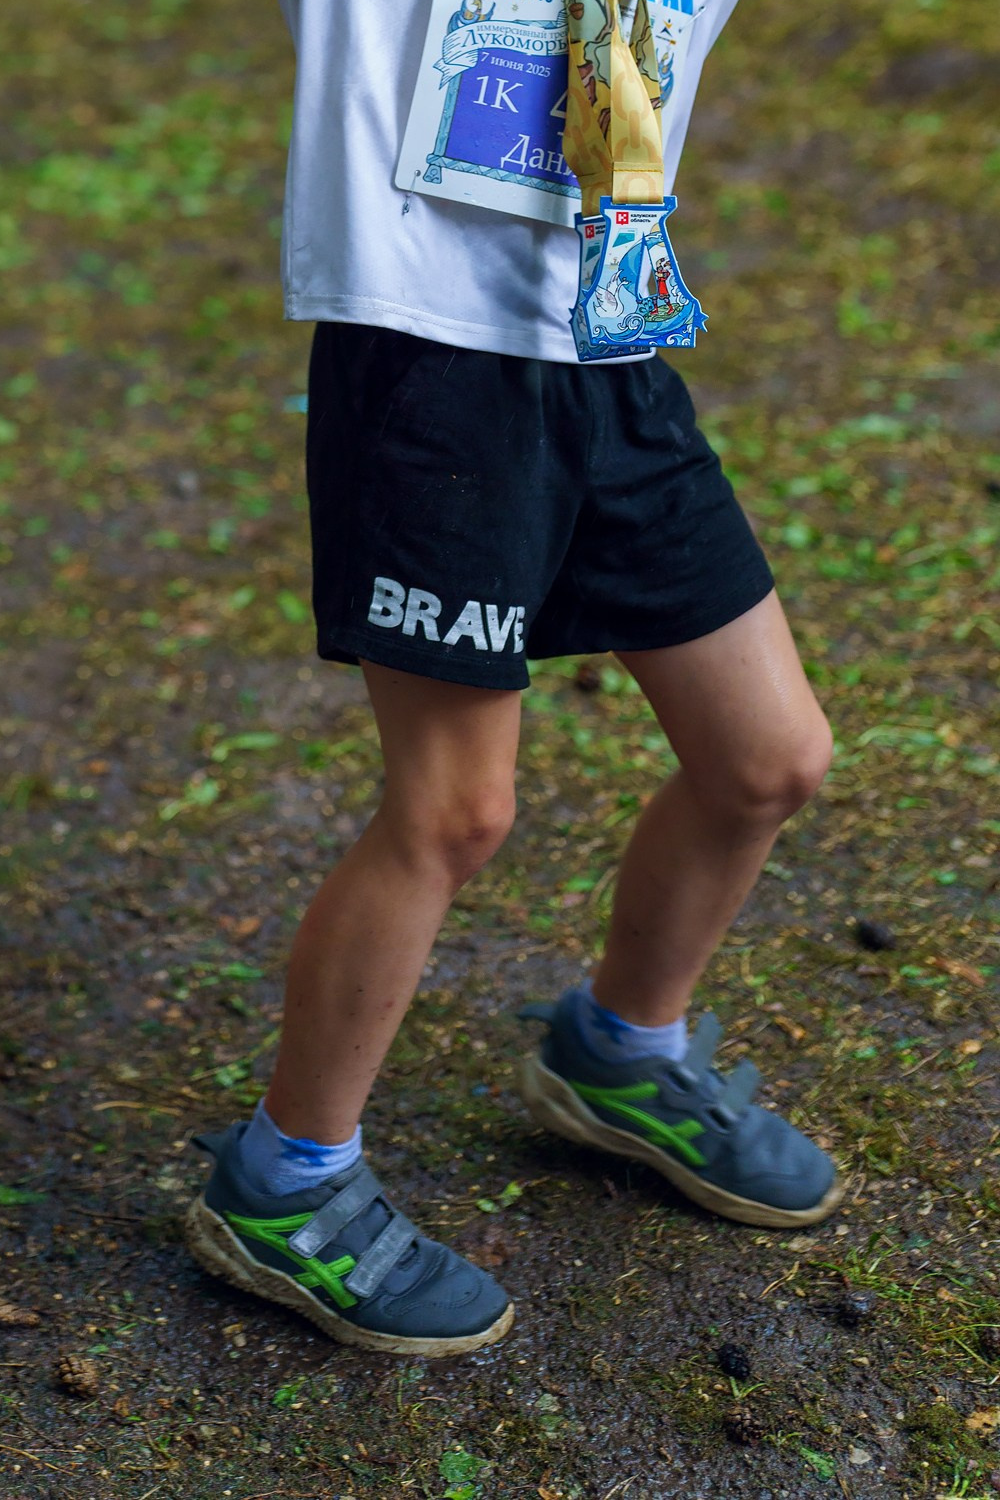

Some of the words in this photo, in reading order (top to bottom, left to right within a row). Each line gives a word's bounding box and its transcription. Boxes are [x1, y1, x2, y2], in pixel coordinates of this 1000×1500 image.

[461, 29, 568, 56] Лукоморь
[476, 24, 548, 40] иммерсивный
[480, 51, 490, 63] 7
[490, 56, 524, 71] июня
[525, 62, 552, 78] 2025
